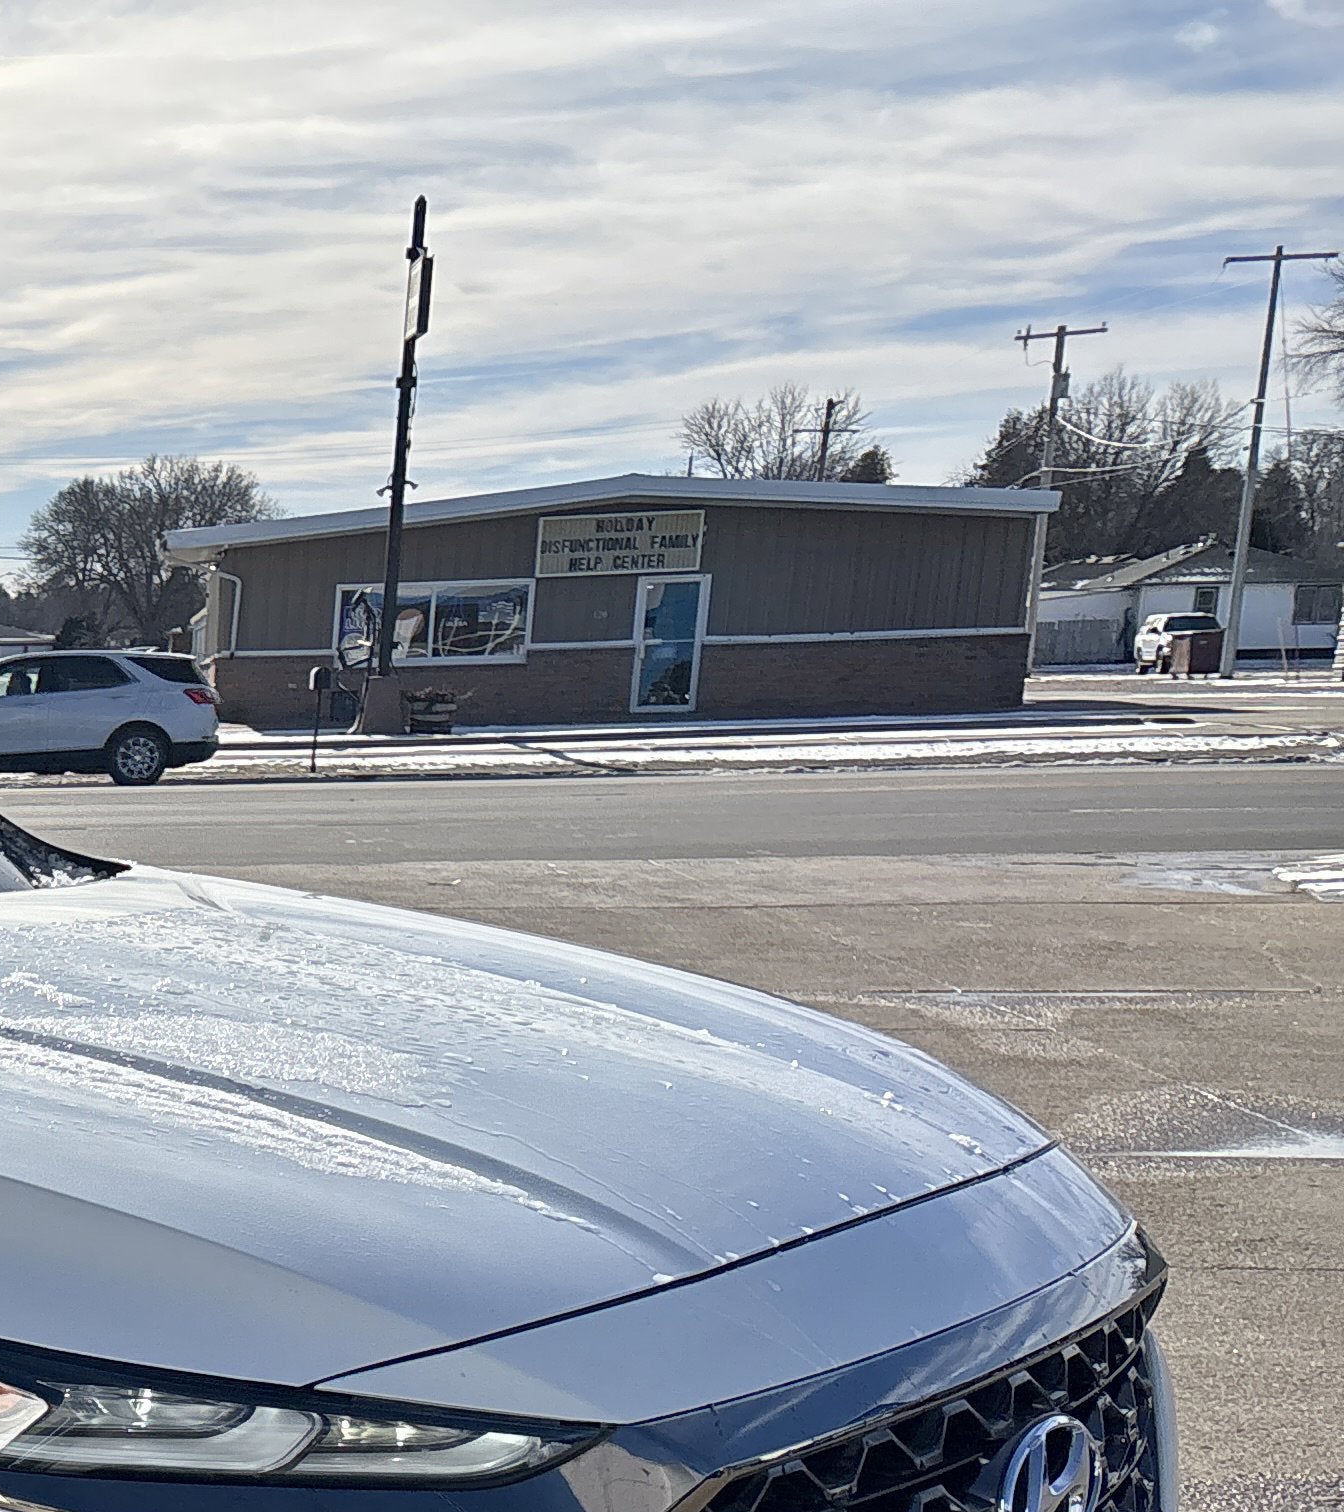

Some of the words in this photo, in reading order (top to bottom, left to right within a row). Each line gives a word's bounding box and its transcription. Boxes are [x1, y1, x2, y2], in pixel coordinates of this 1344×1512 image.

[650, 533, 700, 549] FAMILY
[569, 557, 603, 572] HELP
[613, 553, 665, 569] CENTER
